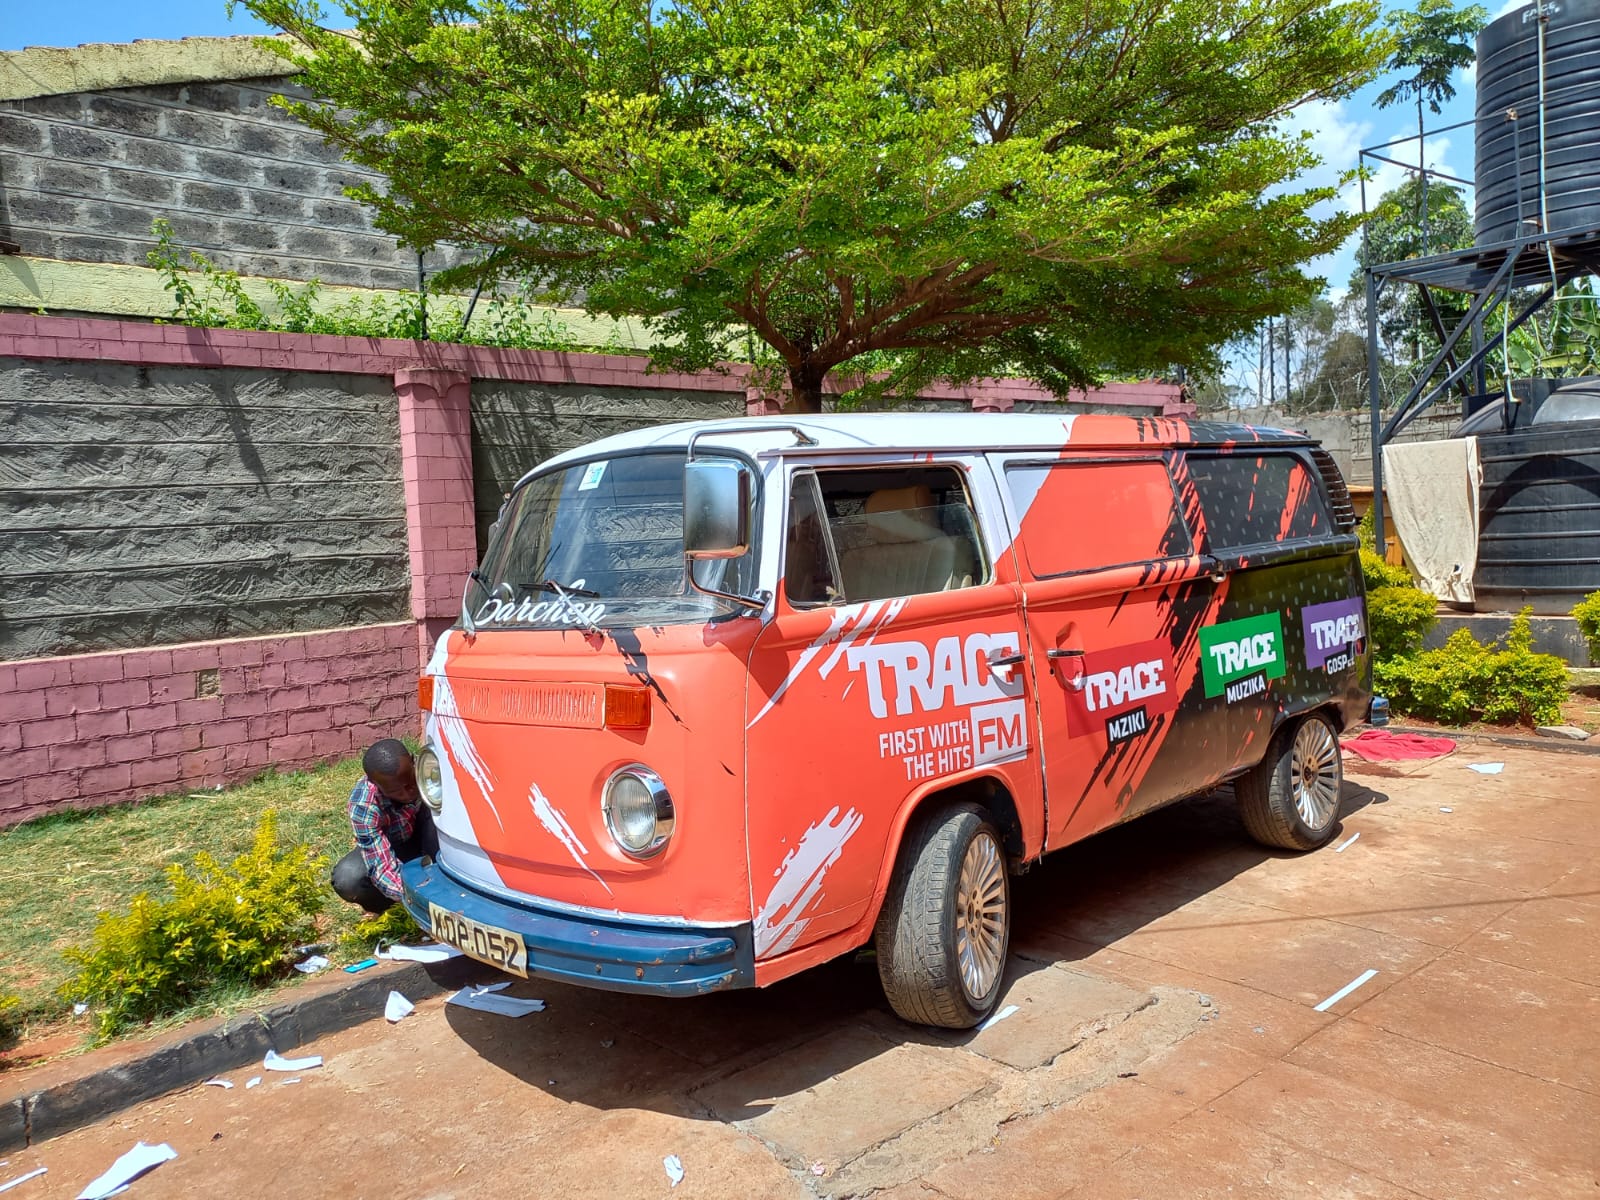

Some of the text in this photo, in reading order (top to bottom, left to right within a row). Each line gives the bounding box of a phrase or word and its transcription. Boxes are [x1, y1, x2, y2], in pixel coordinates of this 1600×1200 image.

[1310, 614, 1362, 650] TRACE
[1209, 632, 1277, 676] TRACE
[846, 631, 1025, 719] TRACE
[1073, 659, 1166, 712] TRACE
[1226, 674, 1266, 704] MUZIKA
[878, 719, 971, 759] FIRST WITH
[977, 713, 1023, 755] FM
[1109, 710, 1146, 742] MZIKI
[903, 745, 972, 781] THE HITS
